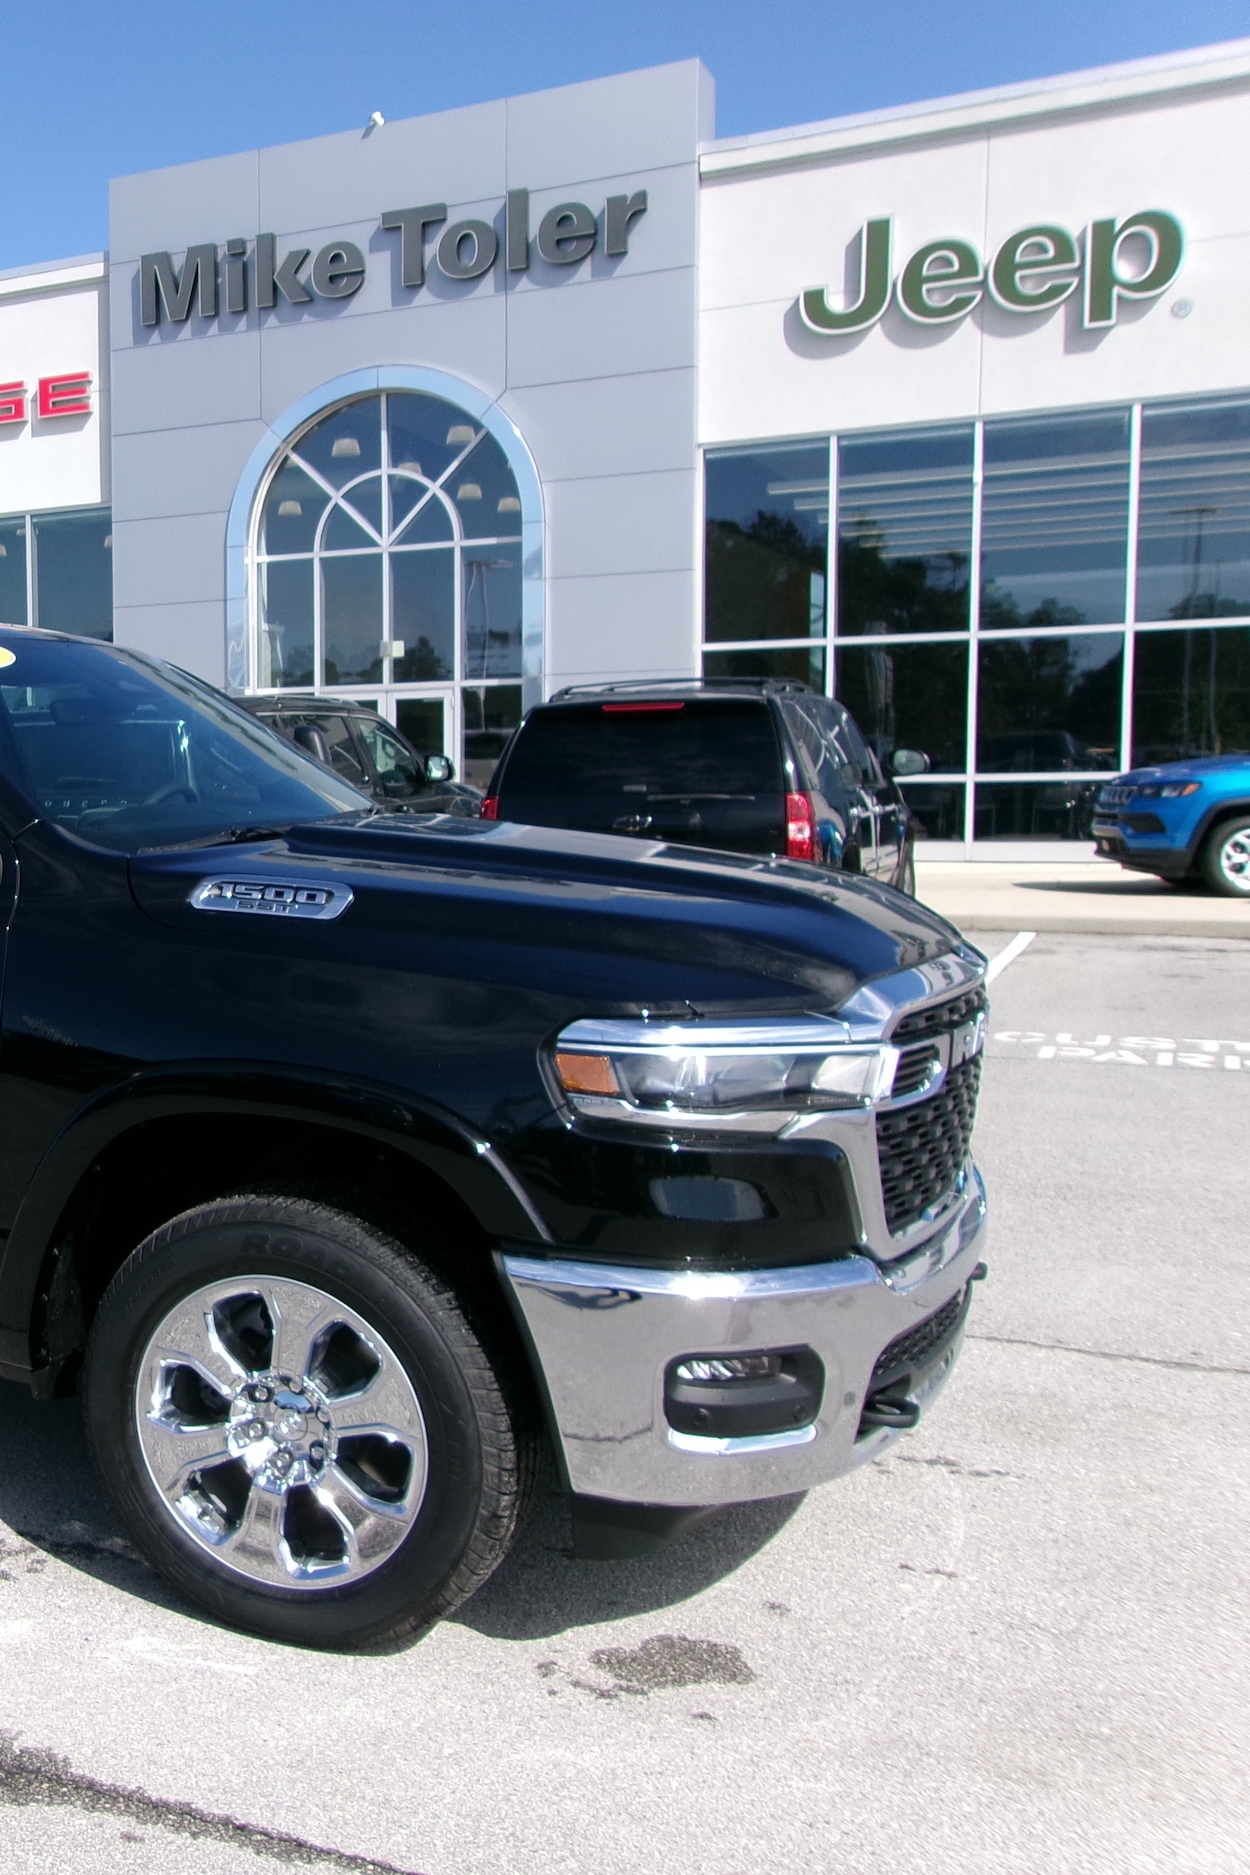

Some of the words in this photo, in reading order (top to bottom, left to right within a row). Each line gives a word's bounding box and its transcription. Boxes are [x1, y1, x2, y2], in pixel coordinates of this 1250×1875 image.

[139, 232, 367, 327] Mike
[380, 187, 648, 288] Toler
[798, 207, 1186, 335] Jeep
[204, 882, 328, 905] 1500
[992, 1030, 1250, 1052] CUST
